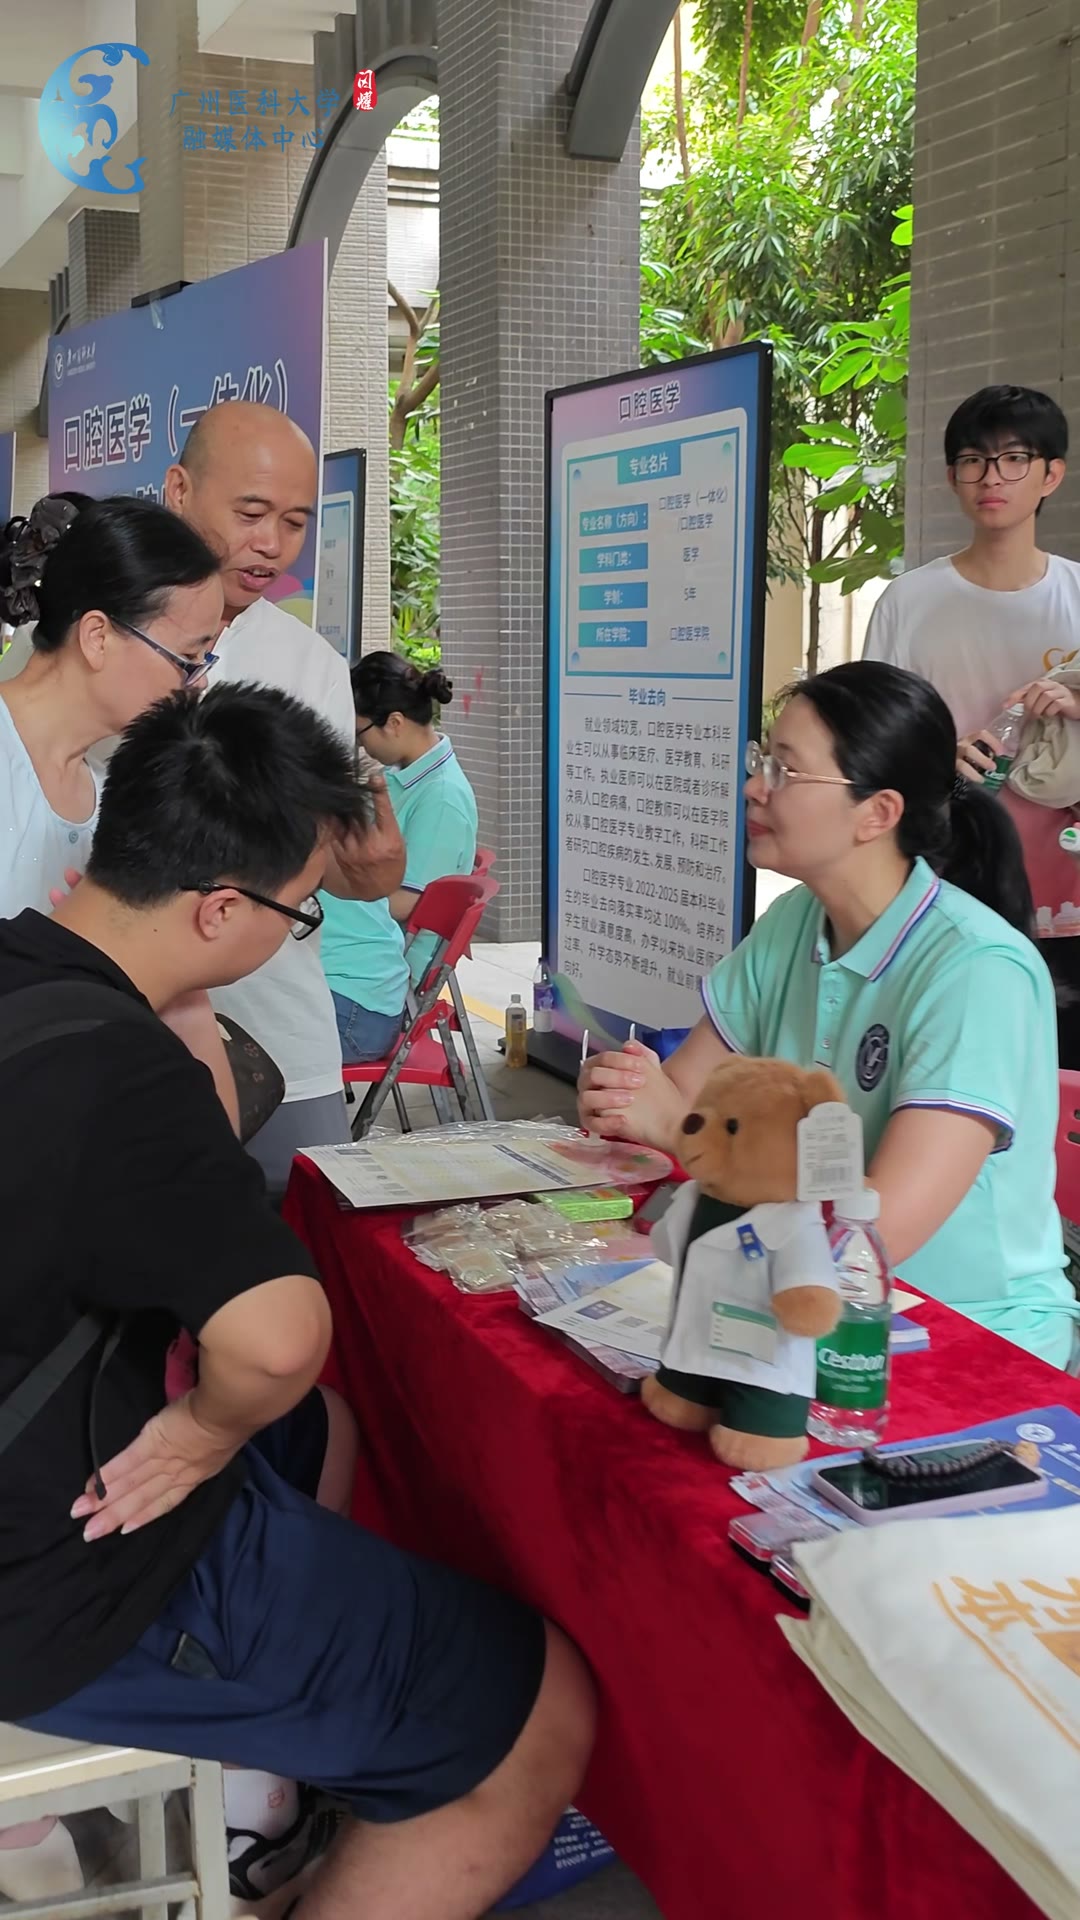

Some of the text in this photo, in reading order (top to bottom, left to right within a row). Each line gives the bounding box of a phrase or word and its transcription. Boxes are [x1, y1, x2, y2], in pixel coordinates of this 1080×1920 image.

[618, 380, 681, 423] 口腔医学
[628, 452, 669, 477] 专业名片
[658, 486, 728, 511] 口腔医学（一体化）
[682, 546, 700, 563] 医学
[683, 586, 697, 601] 5年
[670, 625, 711, 642] 口腔医学院
[628, 688, 667, 707] 毕业去向
[585, 717, 731, 743] 就业领域较宽，口腔医学专业本科毕
[566, 739, 731, 770] 业生可以从事临床医疗、医学教育、科研
[583, 868, 727, 917] 口腔医学专业 2022-2025 届本科毕业
